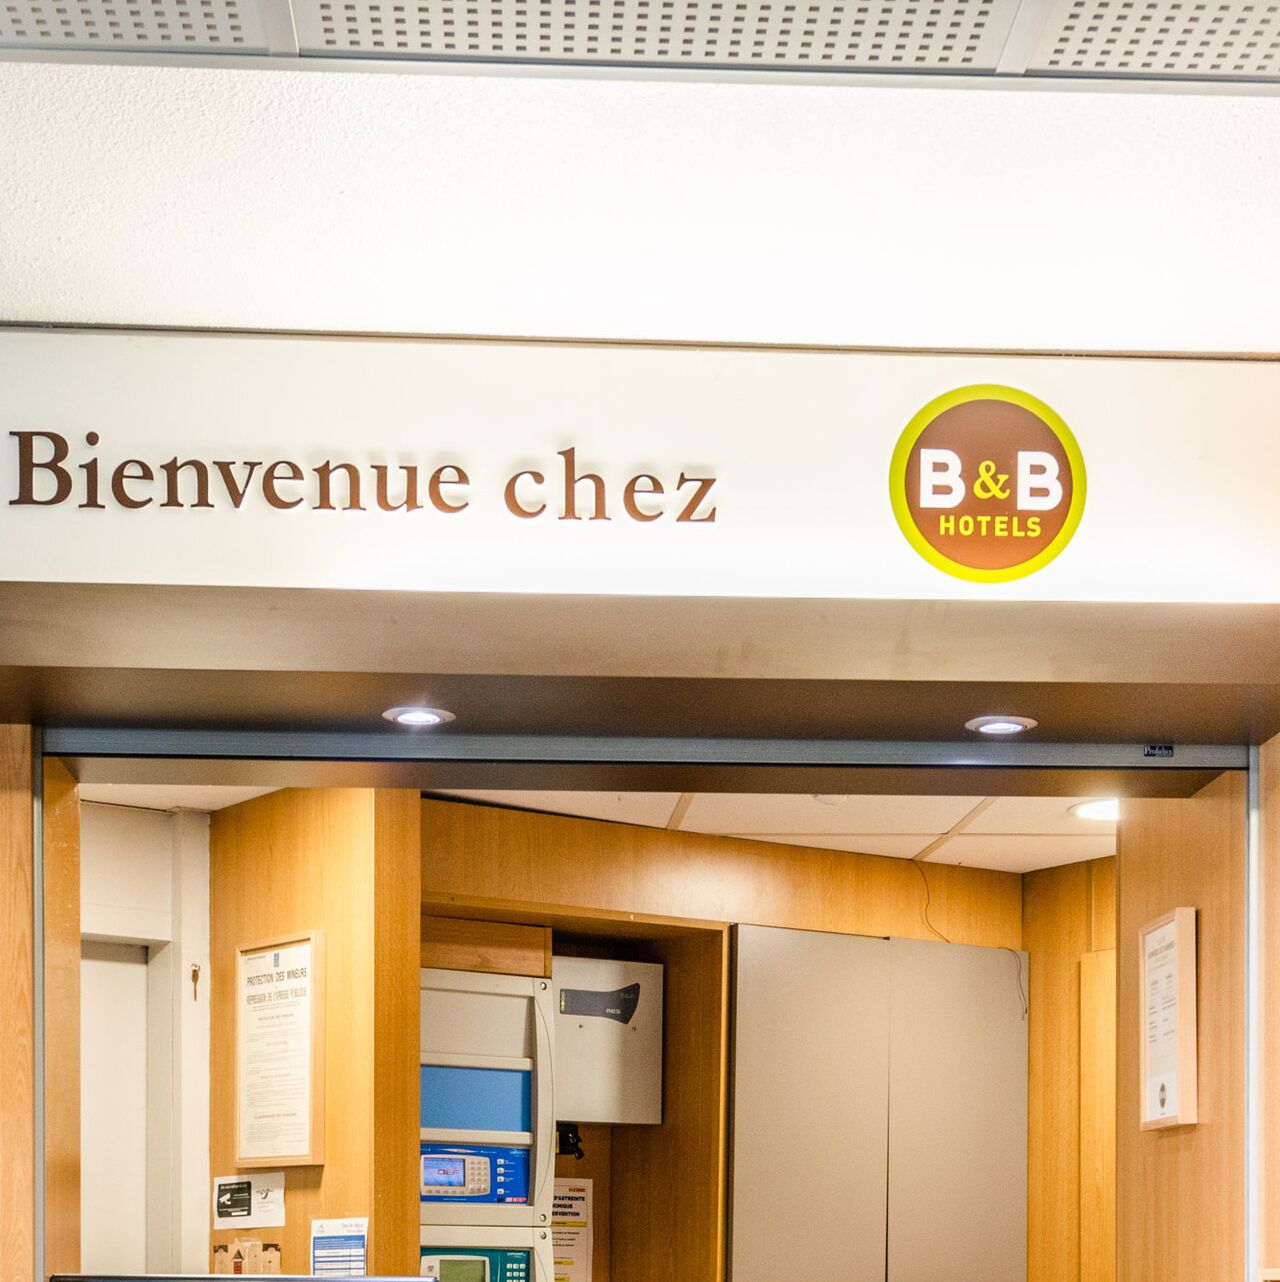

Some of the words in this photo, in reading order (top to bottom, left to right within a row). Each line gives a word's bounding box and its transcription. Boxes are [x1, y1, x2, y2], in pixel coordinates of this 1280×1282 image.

[8, 430, 470, 514] Bienvenue
[503, 446, 717, 523] chez
[919, 448, 1064, 511] B&B
[938, 514, 1042, 538] HOTELS
[275, 970, 285, 982] DES
